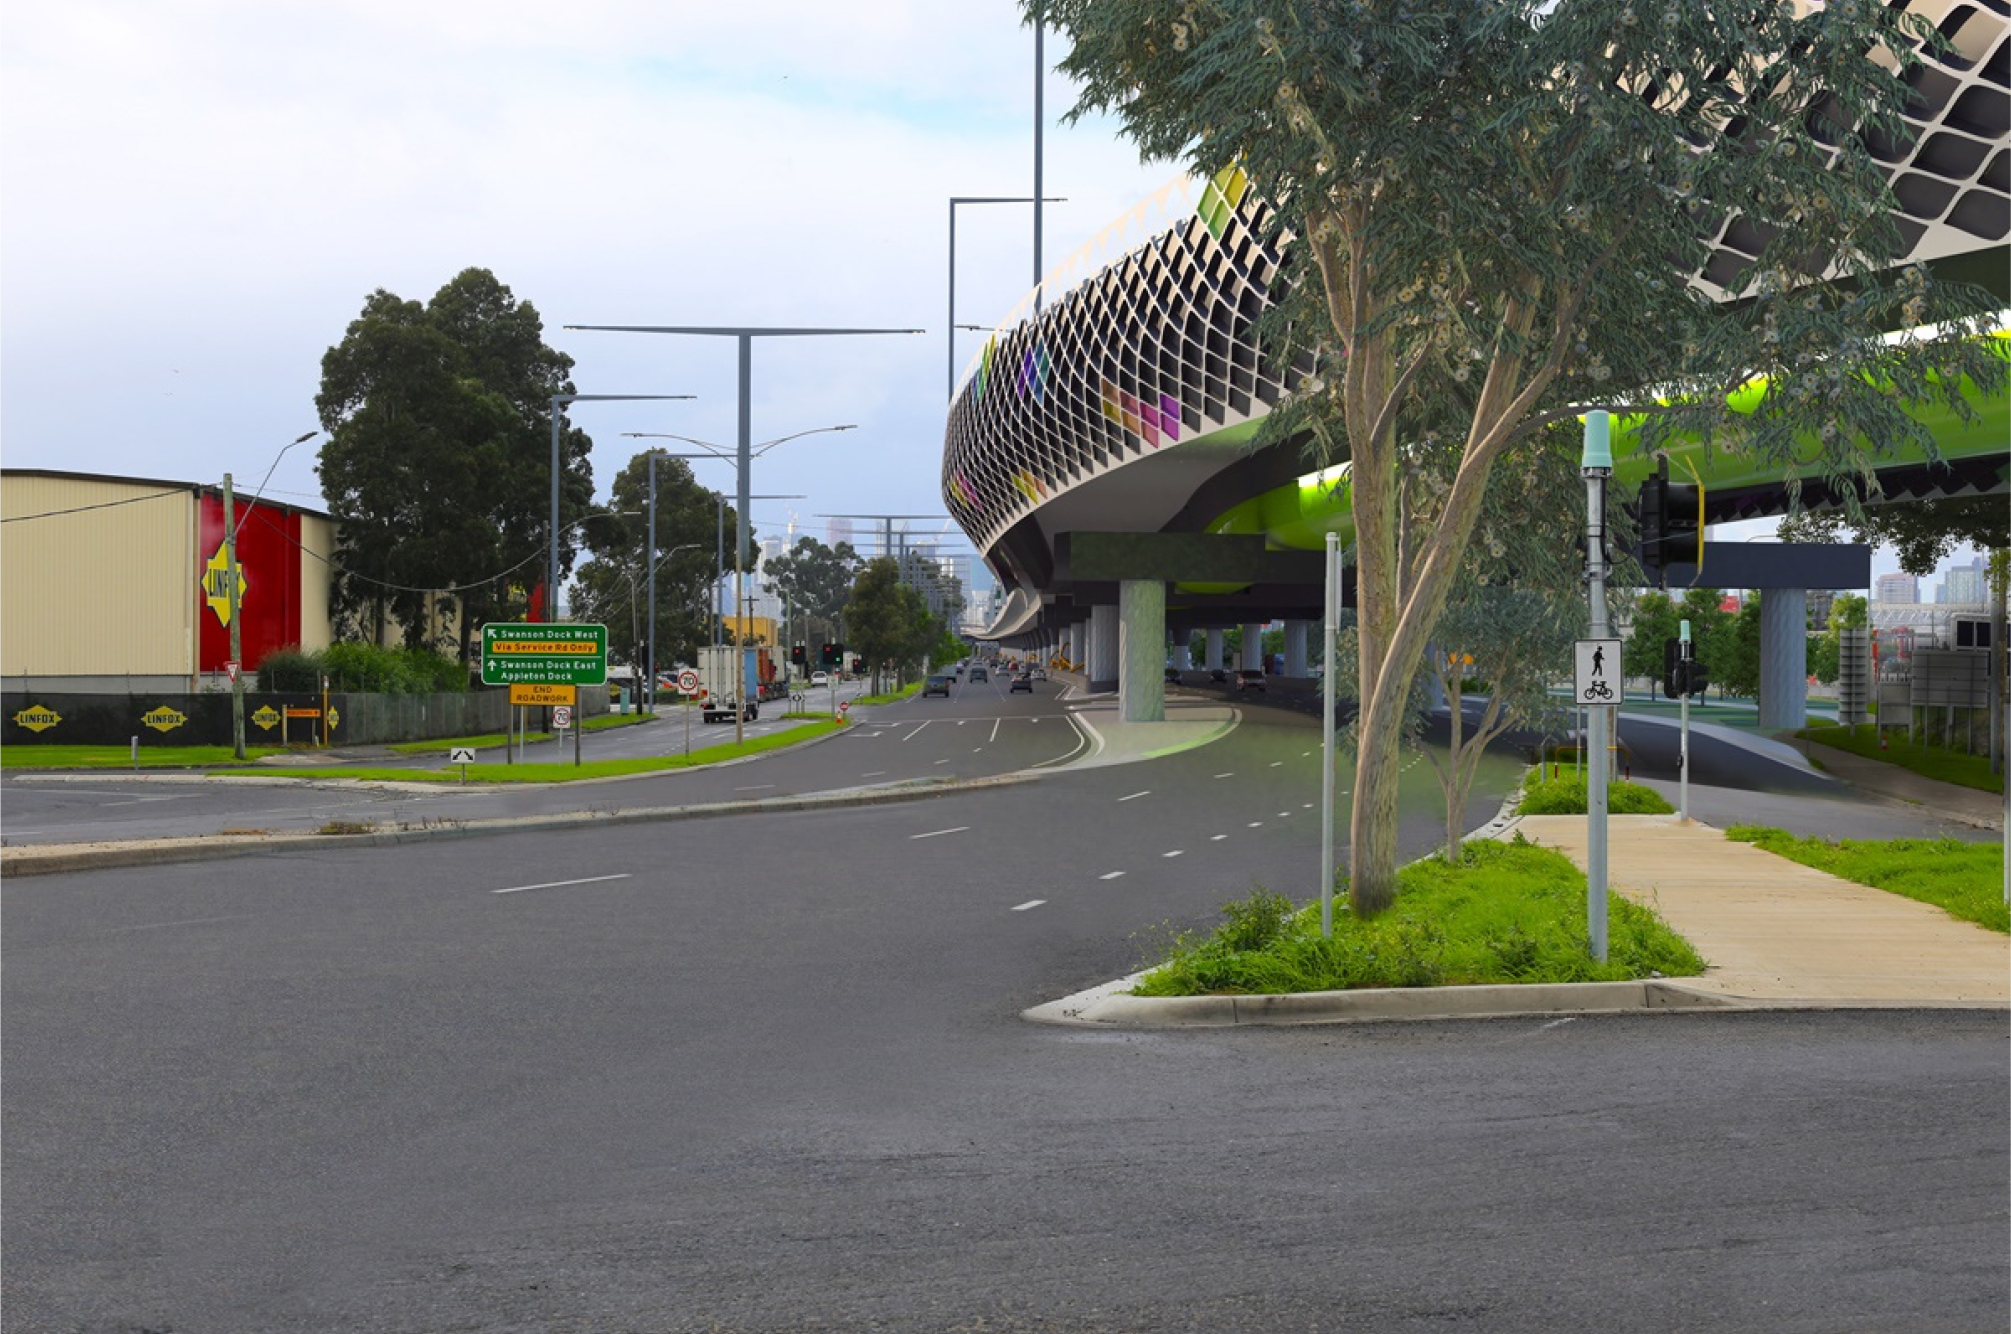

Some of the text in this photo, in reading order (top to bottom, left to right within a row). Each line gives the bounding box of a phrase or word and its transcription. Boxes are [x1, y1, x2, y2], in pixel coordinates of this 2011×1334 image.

[208, 569, 241, 598] LINF
[501, 630, 598, 639] Swanson Dock West
[495, 643, 594, 652] Via Service Rd Only
[501, 660, 597, 669] Swanson Dock East
[501, 672, 573, 681] Appleton Dock
[683, 676, 694, 685] 70
[533, 686, 552, 694] END
[516, 694, 568, 702] ROADWORK
[20, 714, 55, 723] LINFOX
[147, 714, 181, 724] LINFOX
[557, 712, 568, 721] 70
